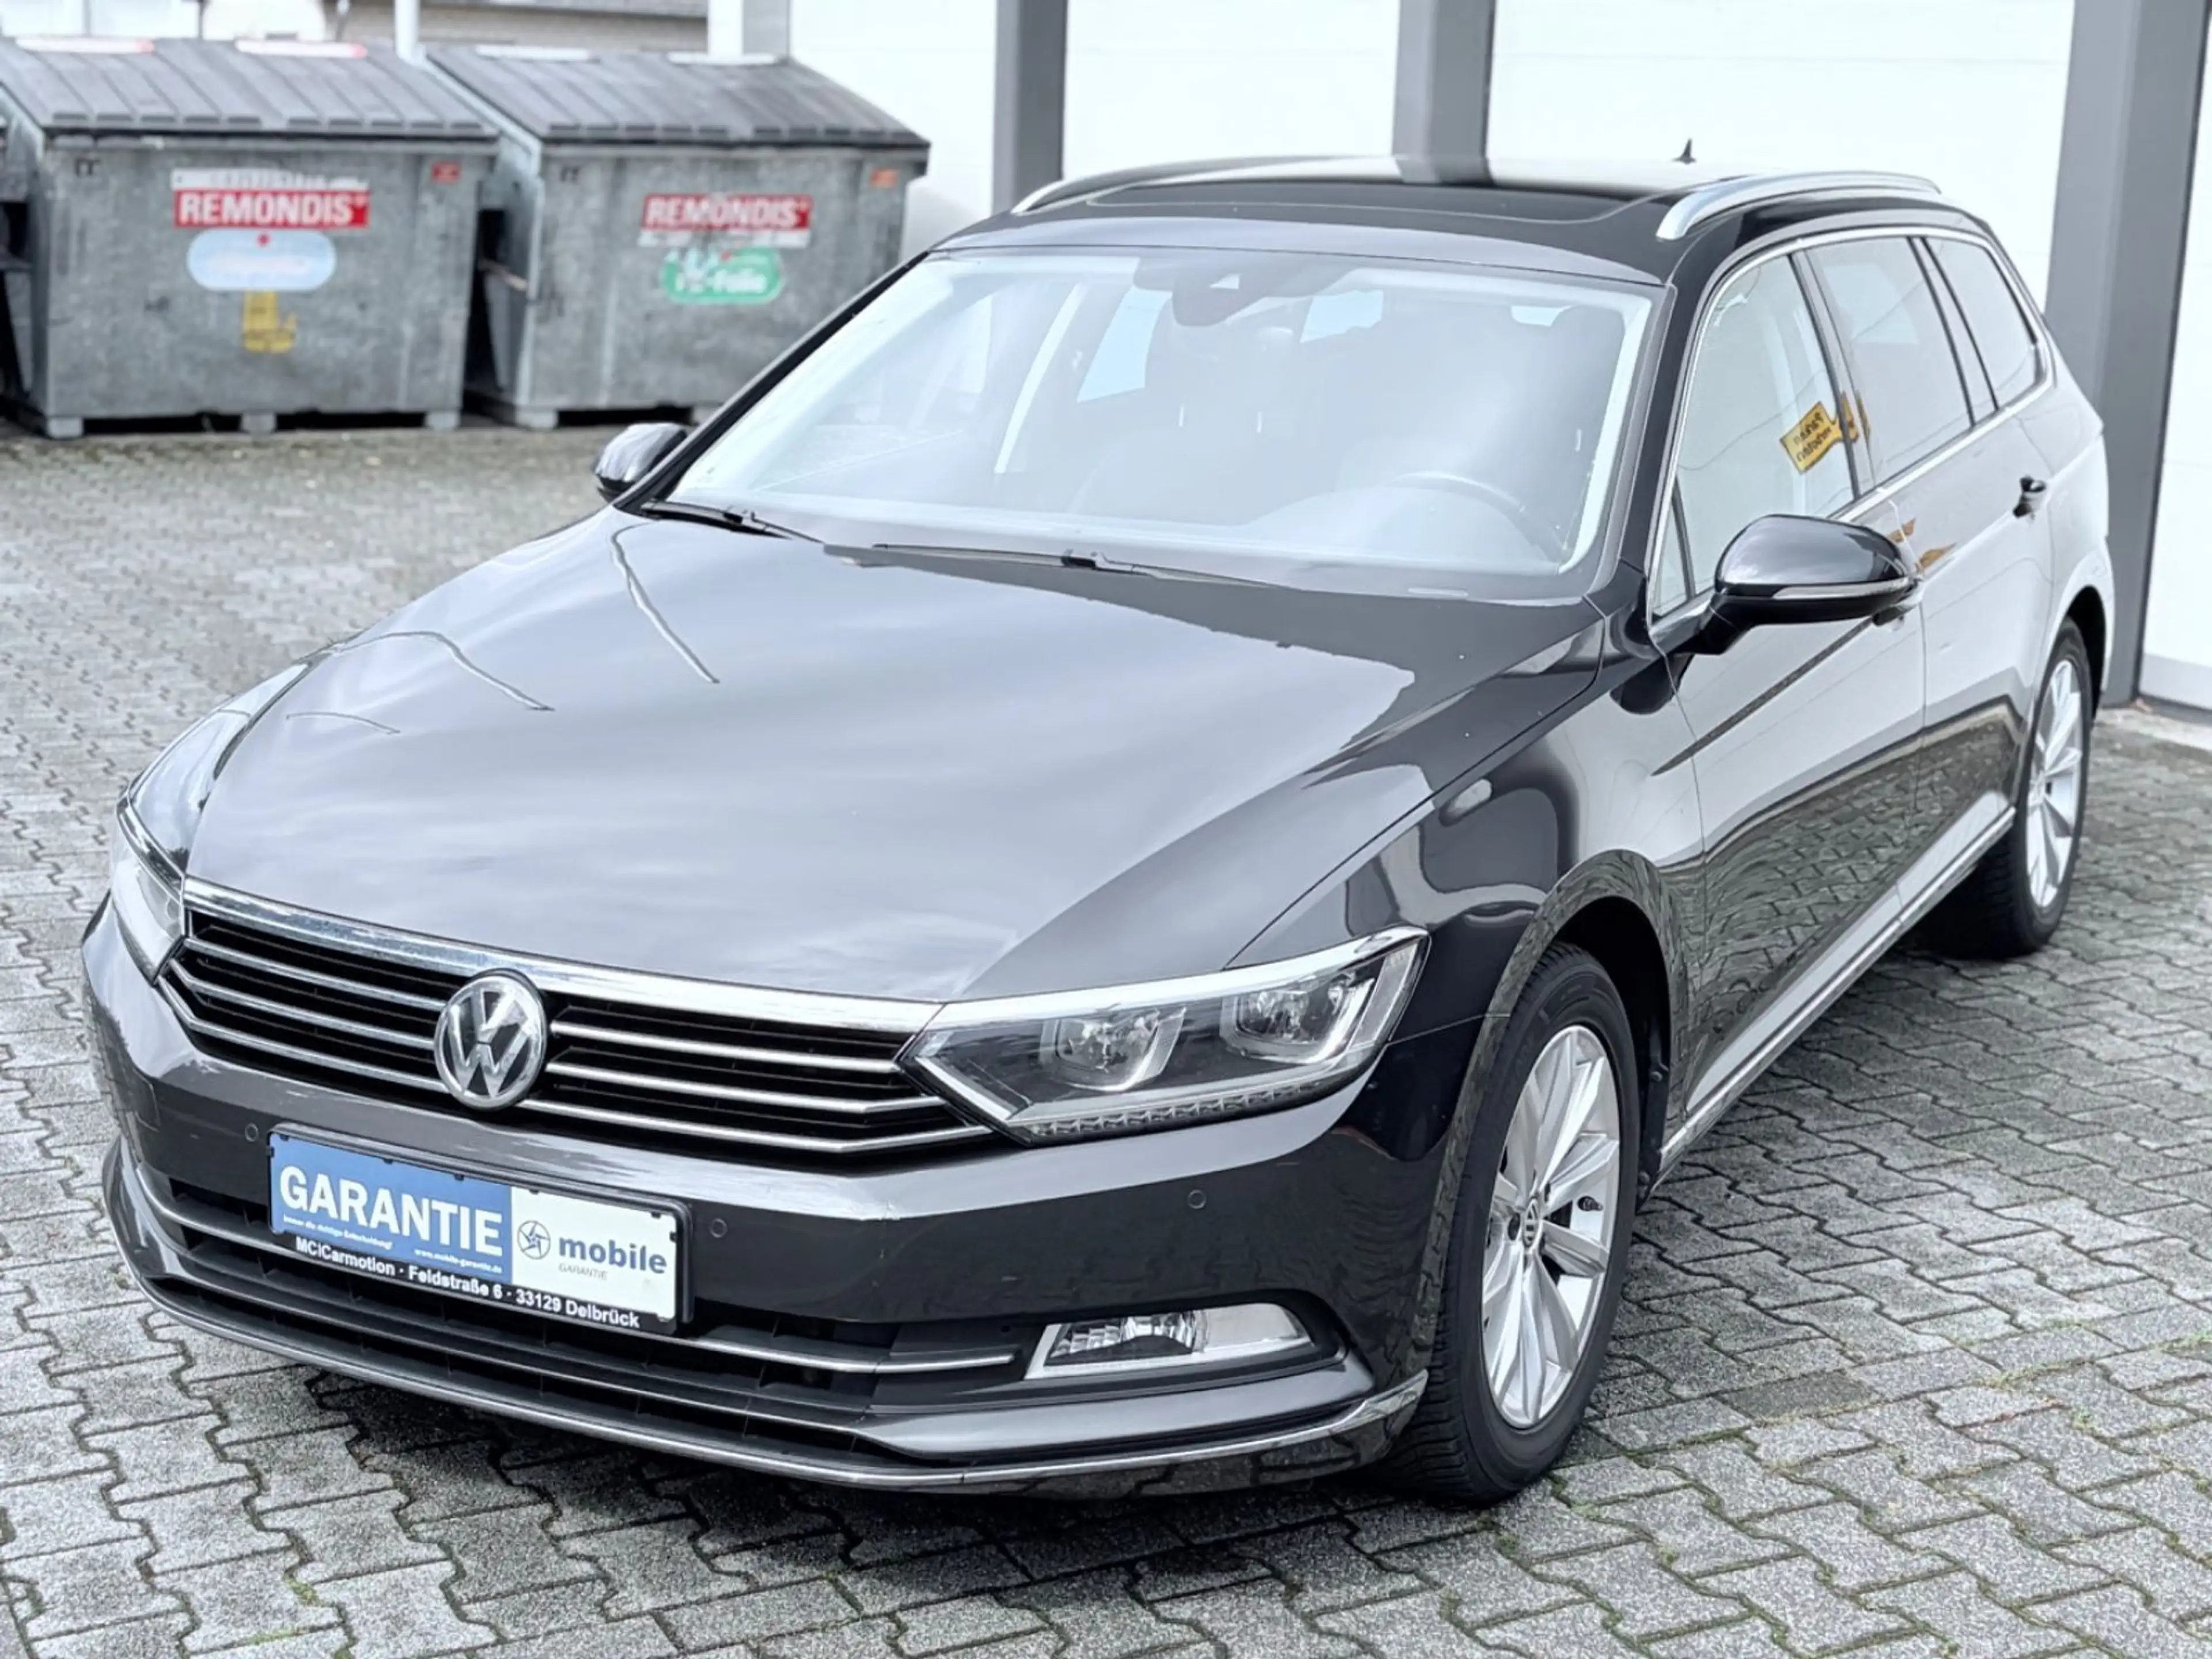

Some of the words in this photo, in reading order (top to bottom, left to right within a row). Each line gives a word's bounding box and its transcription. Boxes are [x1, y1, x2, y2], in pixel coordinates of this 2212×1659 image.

[179, 192, 353, 226] REMONDIS
[645, 198, 796, 228] REMONDIS
[280, 1165, 503, 1257] GARANTIE
[558, 1237, 668, 1274] mobile
[408, 1264, 489, 1297] Feldstraße
[493, 1283, 503, 1300] 6
[516, 1288, 562, 1313] 33129
[565, 1299, 641, 1328] Delbrück
